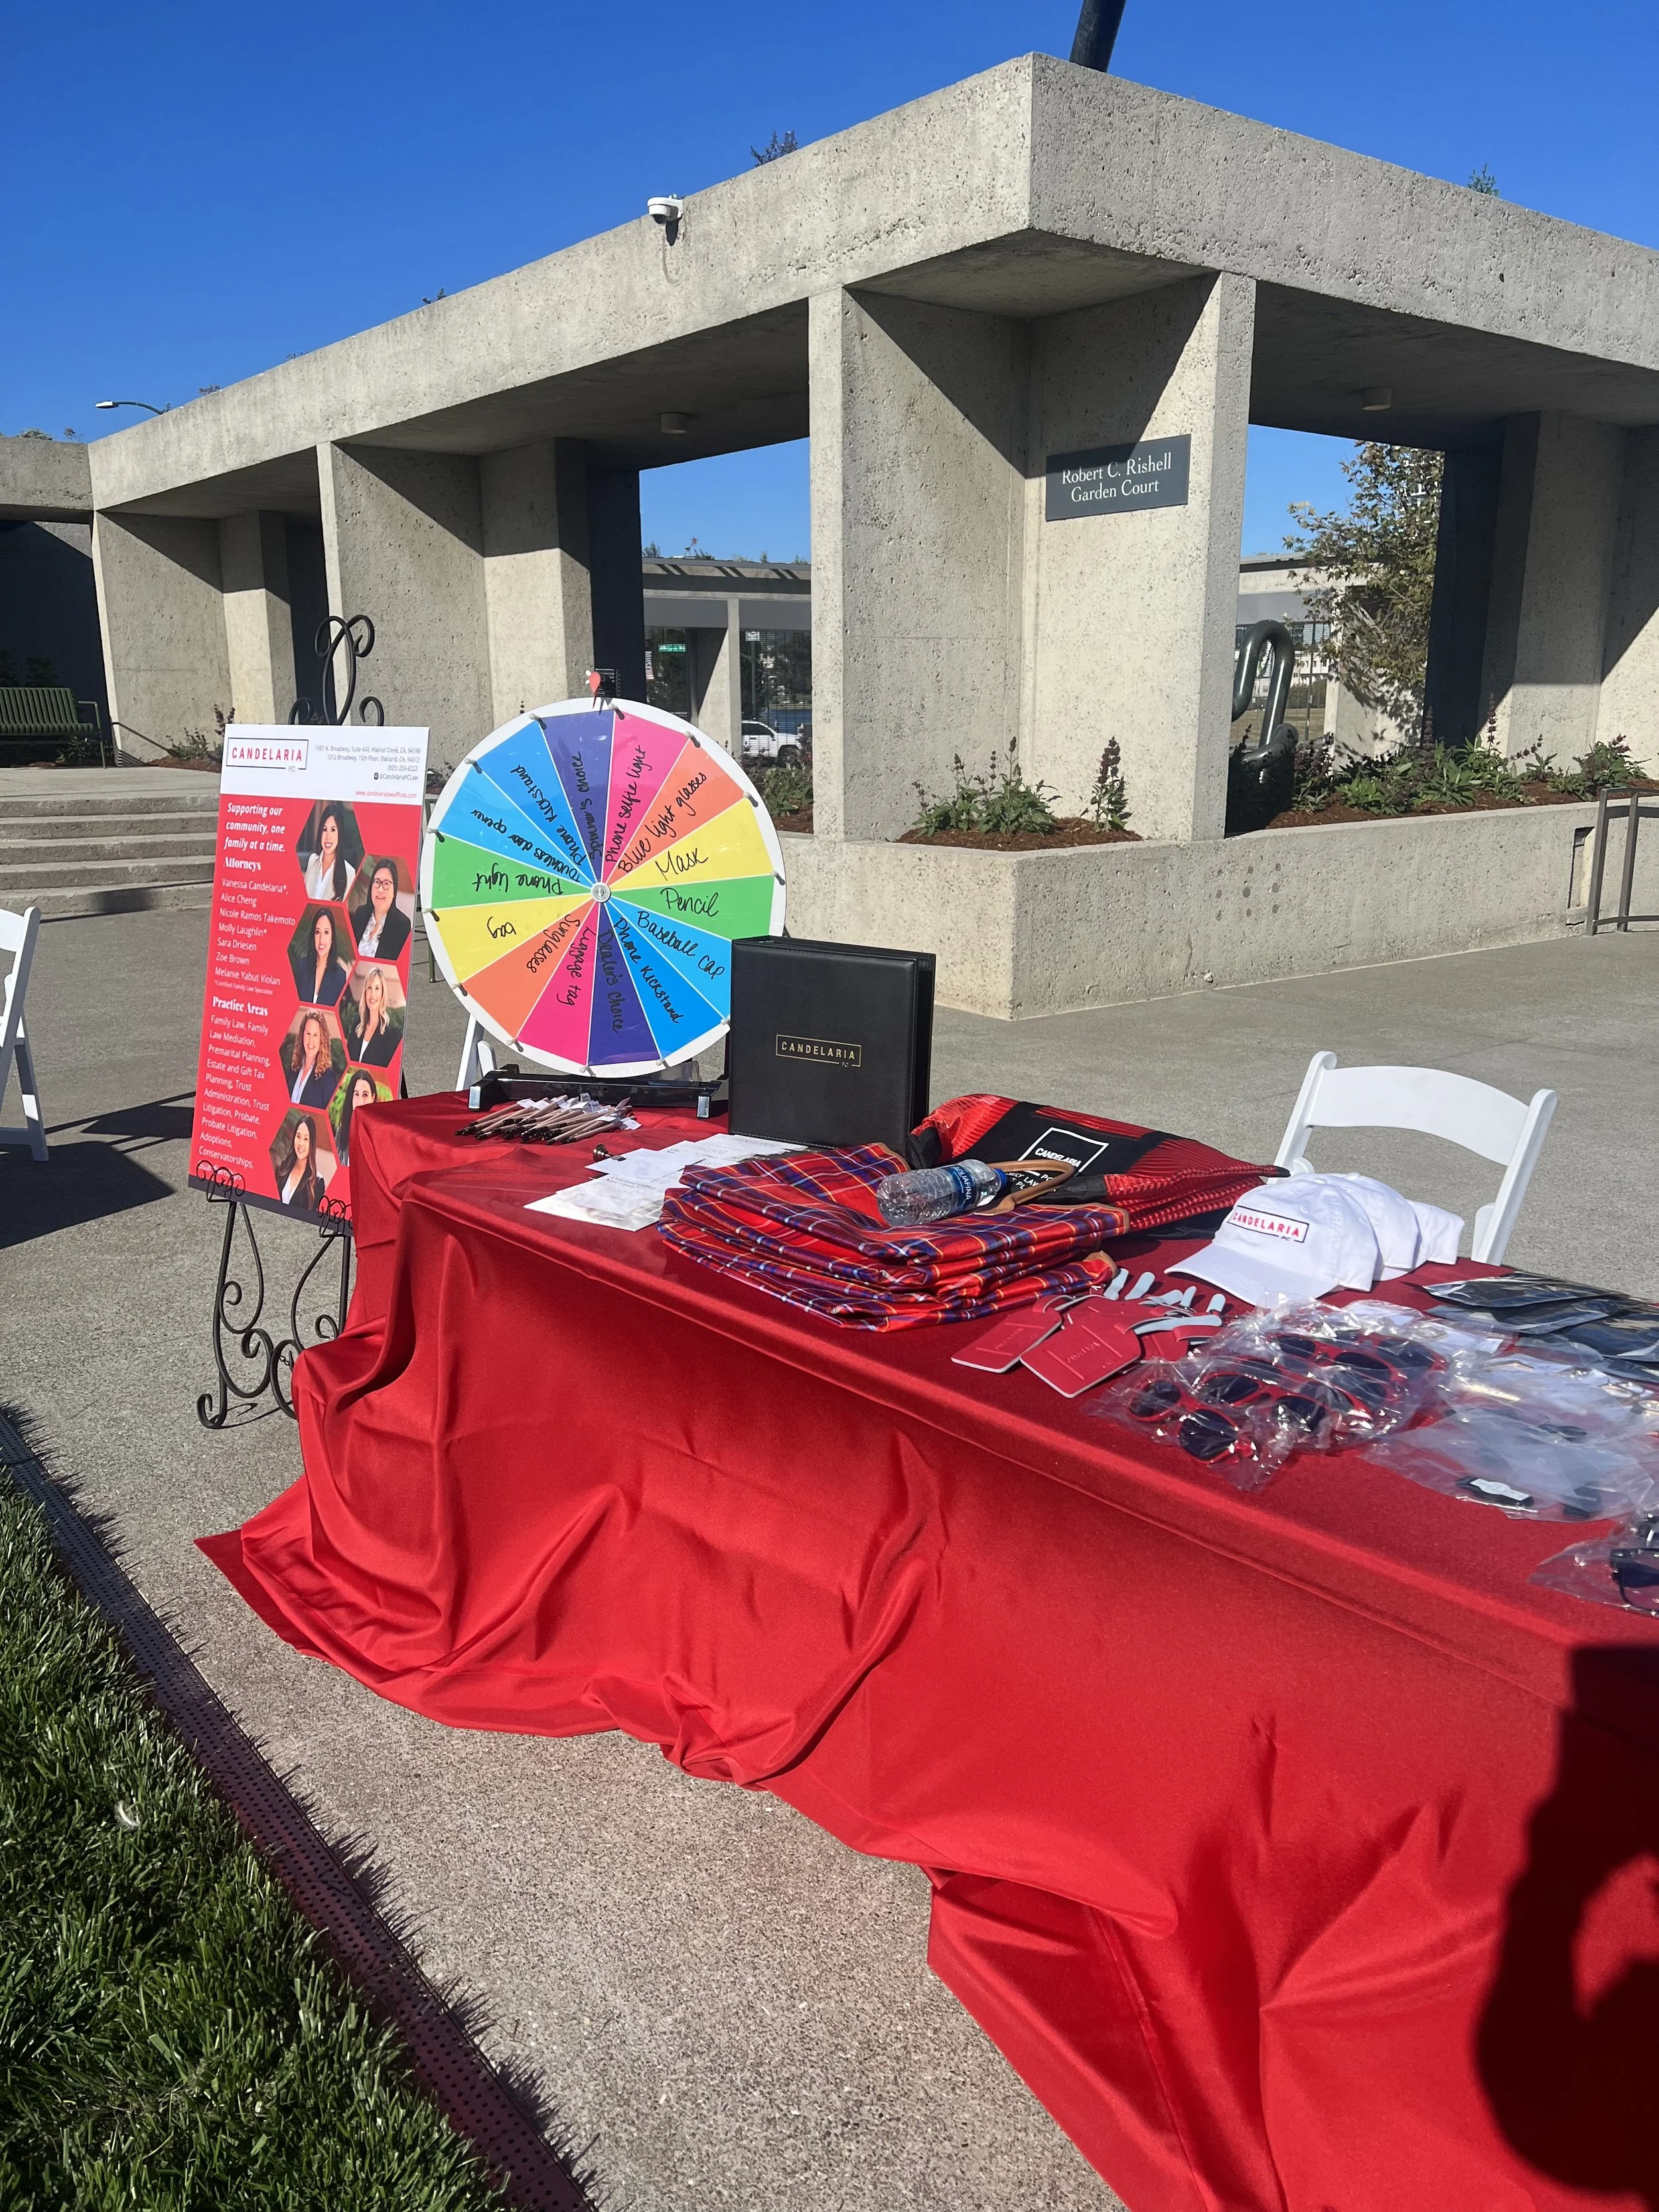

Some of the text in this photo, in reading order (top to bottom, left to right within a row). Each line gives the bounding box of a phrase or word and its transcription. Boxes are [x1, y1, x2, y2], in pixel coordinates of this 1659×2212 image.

[1062, 451, 1171, 484] Robert C. Rishell
[1071, 479, 1160, 502] Garden Court
[232, 747, 302, 761] CANDELARIA
[227, 802, 268, 818] Supporting
[606, 745, 652, 862] Phone selfie light
[226, 822, 285, 836] community, one
[470, 809, 507, 834] opener
[580, 798, 603, 861] Spinner's
[618, 773, 707, 873] Blue light glasses
[223, 836, 285, 852] family at a time.
[508, 834, 534, 851] door
[556, 824, 587, 866] Phone
[223, 856, 261, 872] Attorneys
[655, 848, 708, 881] Mask
[222, 878, 248, 889] Vanessa
[472, 862, 563, 895] Phone light
[220, 893, 257, 908] Alice Cheng
[660, 887, 719, 917] Pencil
[220, 908, 296, 926] Nicole Ramos Takemoto
[486, 917, 516, 938] bag
[218, 922, 236, 935] Molly
[638, 911, 698, 956] Baseball
[217, 937, 257, 951] Sara Driesen
[526, 914, 581, 973] Sunglasses
[613, 917, 642, 964] Phone
[216, 952, 250, 965] Zoe Brown
[556, 926, 597, 1006] Luggage tag
[598, 928, 622, 986] Dealer's
[215, 967, 281, 986] Melanie Yabut Violan
[233, 983, 246, 992] Family
[212, 995, 268, 1017] Practice Areas
[210, 1015, 268, 1035] Family Law, Family
[209, 1030, 256, 1048] Law Mediation,
[208, 1044, 271, 1067] Premarital Planning,
[781, 1041, 855, 1060] CANDELARIA
[207, 1059, 265, 1079] Estate and Gift Tax
[205, 1073, 252, 1092] Planning, Trust
[204, 1088, 269, 1112] Administration, Trust
[202, 1103, 261, 1126] Litigation, Probate,
[201, 1117, 257, 1140] Probate Litigation,
[200, 1132, 233, 1148] Adoptions,
[199, 1145, 253, 1169] Conservatorships,
[1035, 1147, 1082, 1168] CANDELARIA
[950, 1166, 972, 1200] AQUAFINA
[1233, 1213, 1299, 1237] CANDELARIA
